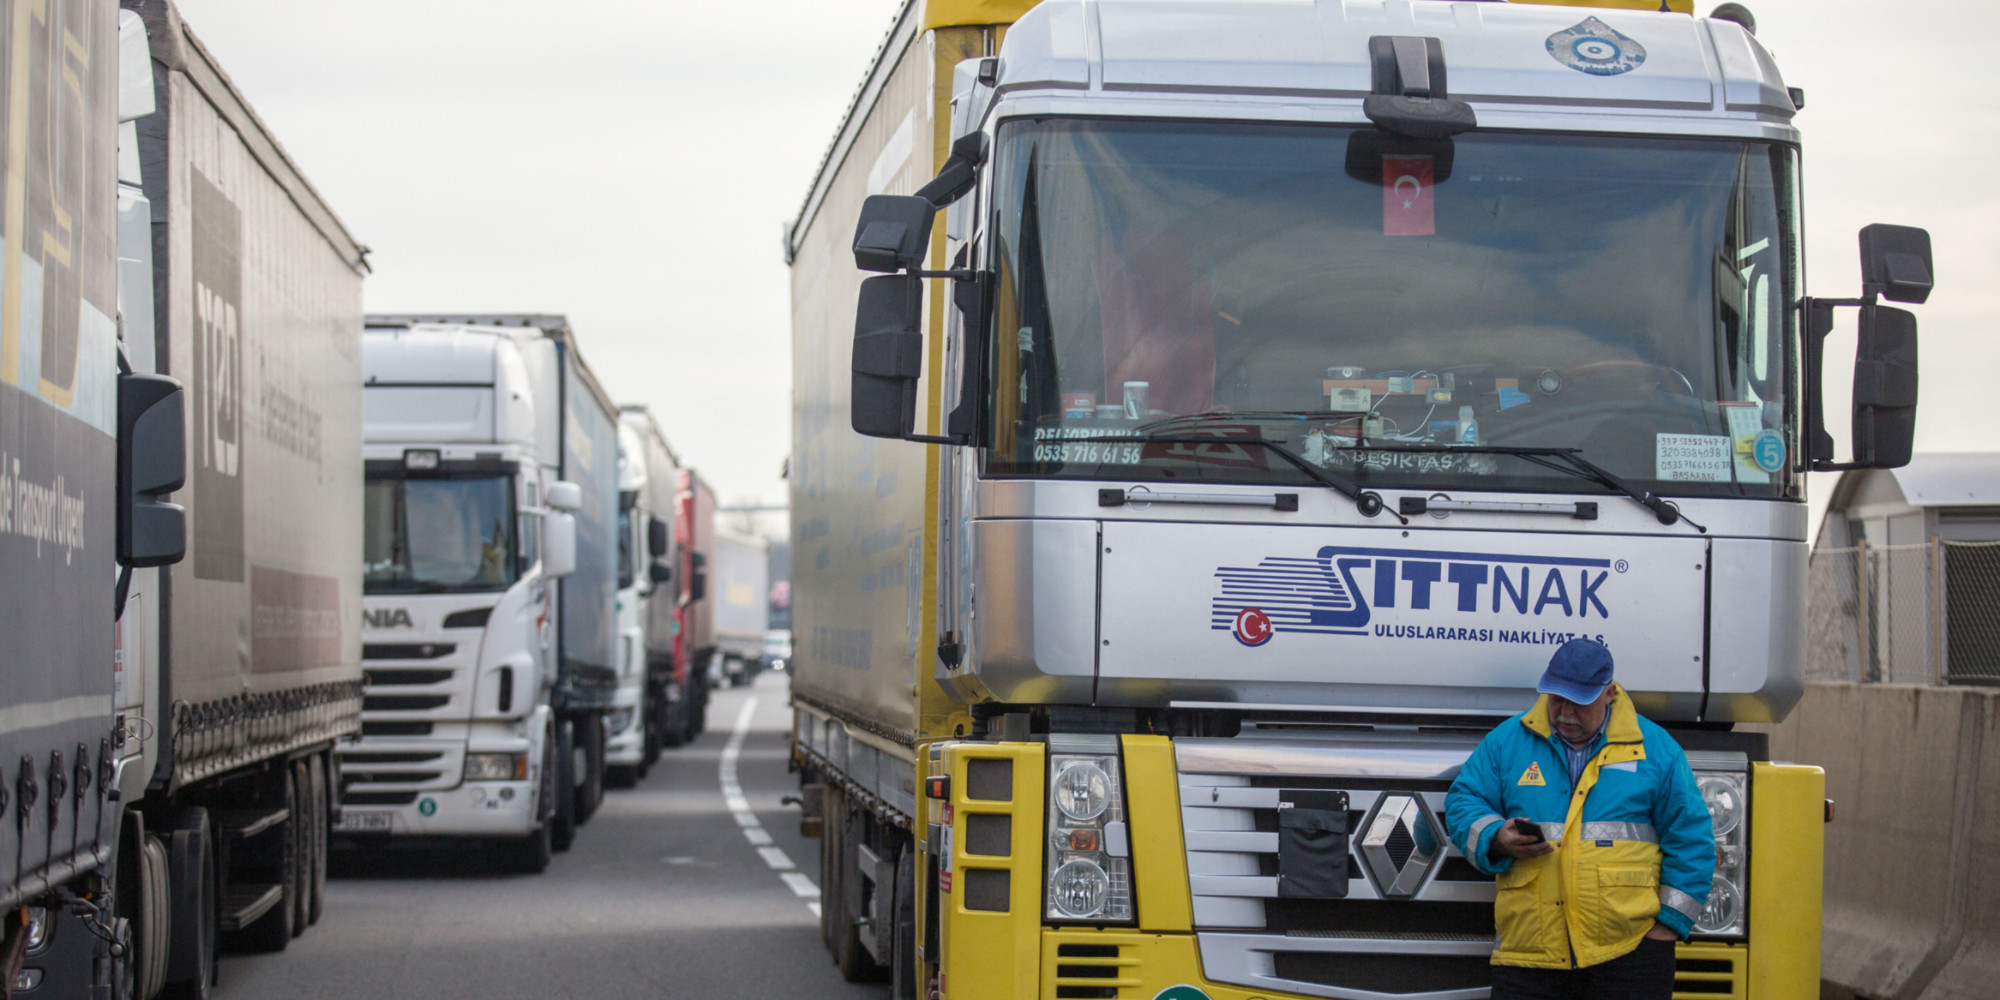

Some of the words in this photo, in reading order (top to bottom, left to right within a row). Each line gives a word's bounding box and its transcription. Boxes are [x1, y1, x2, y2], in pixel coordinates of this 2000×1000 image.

[1034, 444, 1069, 462] 0535
[1074, 446, 1097, 463] 716
[1102, 447, 1118, 463] 61
[1121, 447, 1140, 464] 56
[1764, 444, 1779, 466] 5
[13, 457, 56, 559] Transport
[57, 474, 84, 566] Urgent
[1310, 545, 1611, 628] SITTNAK
[1375, 624, 1493, 642] ULUSLARARASI
[1499, 628, 1575, 646] NAKLİYAT
